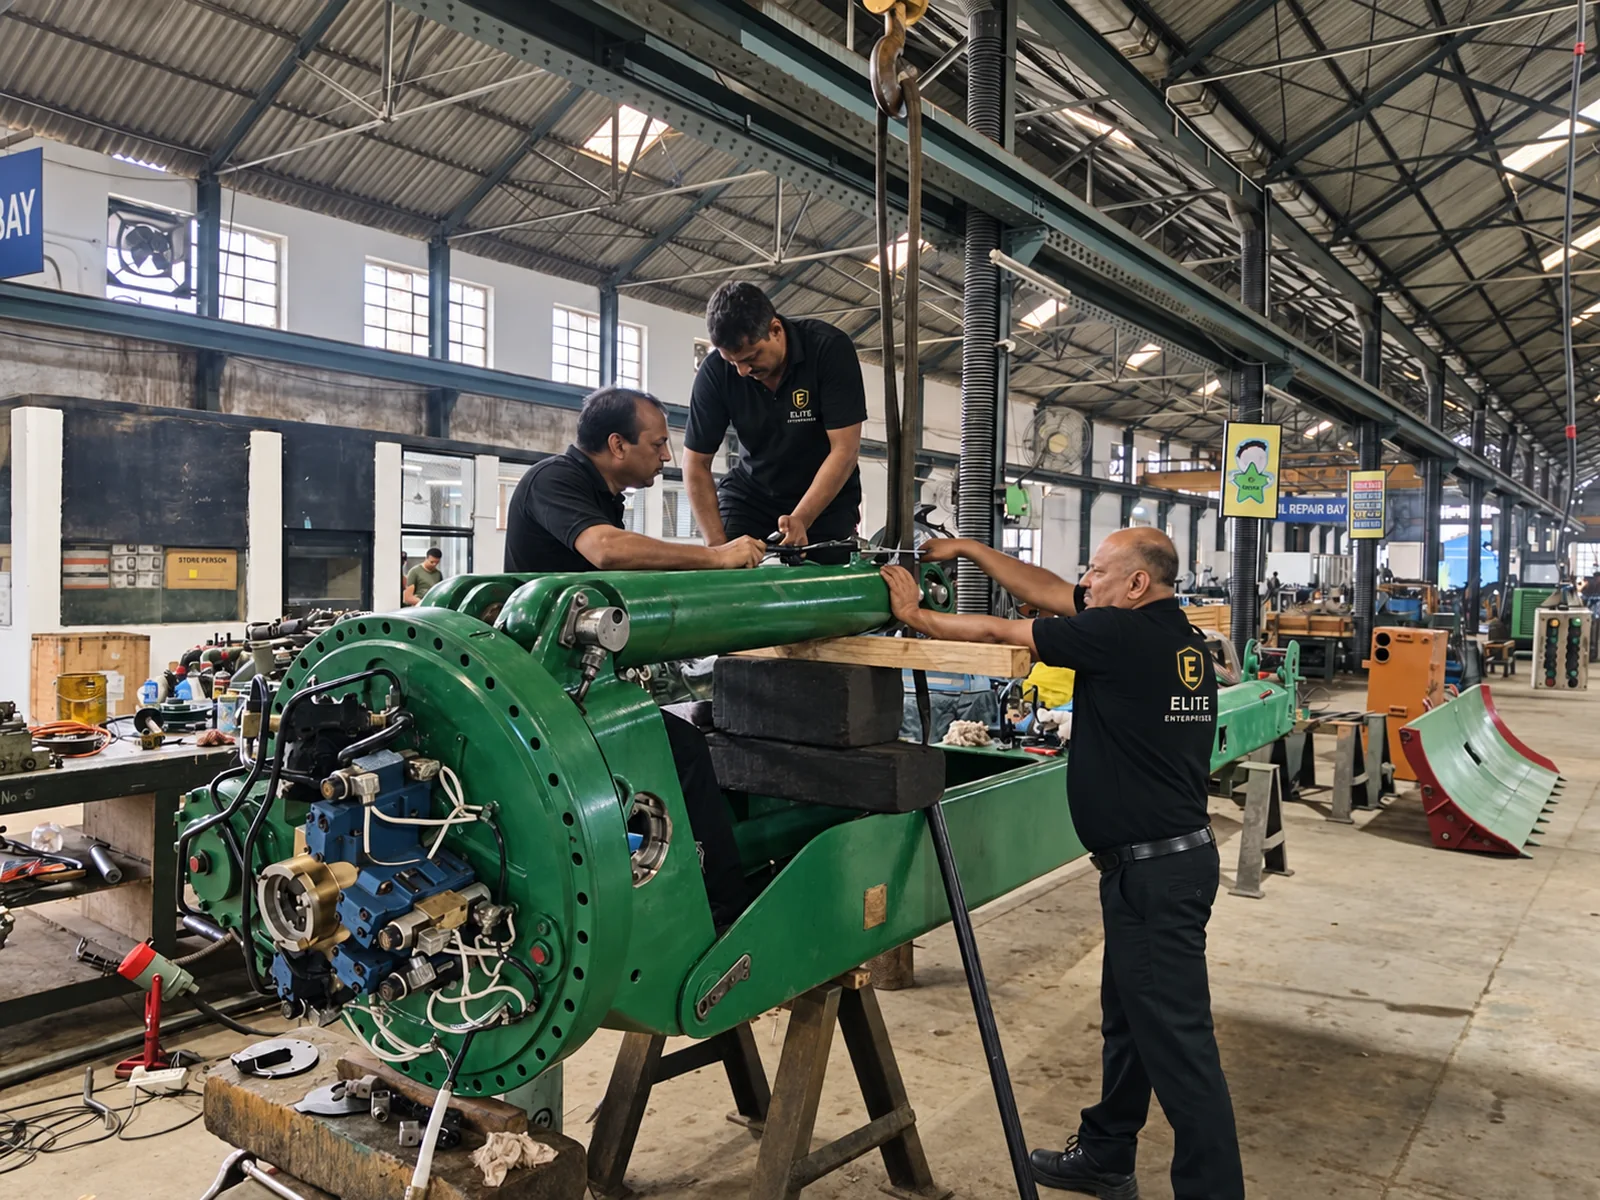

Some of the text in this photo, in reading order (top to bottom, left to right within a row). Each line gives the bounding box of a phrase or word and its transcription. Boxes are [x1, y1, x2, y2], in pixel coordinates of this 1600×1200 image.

[790, 409, 812, 419] ELITE
[1289, 503, 1325, 515] REPAIR
[1326, 503, 1346, 515] BAY
[178, 556, 227, 564] STORE PERSON
[1183, 656, 1199, 682] E
[1170, 696, 1210, 711] ELITE
